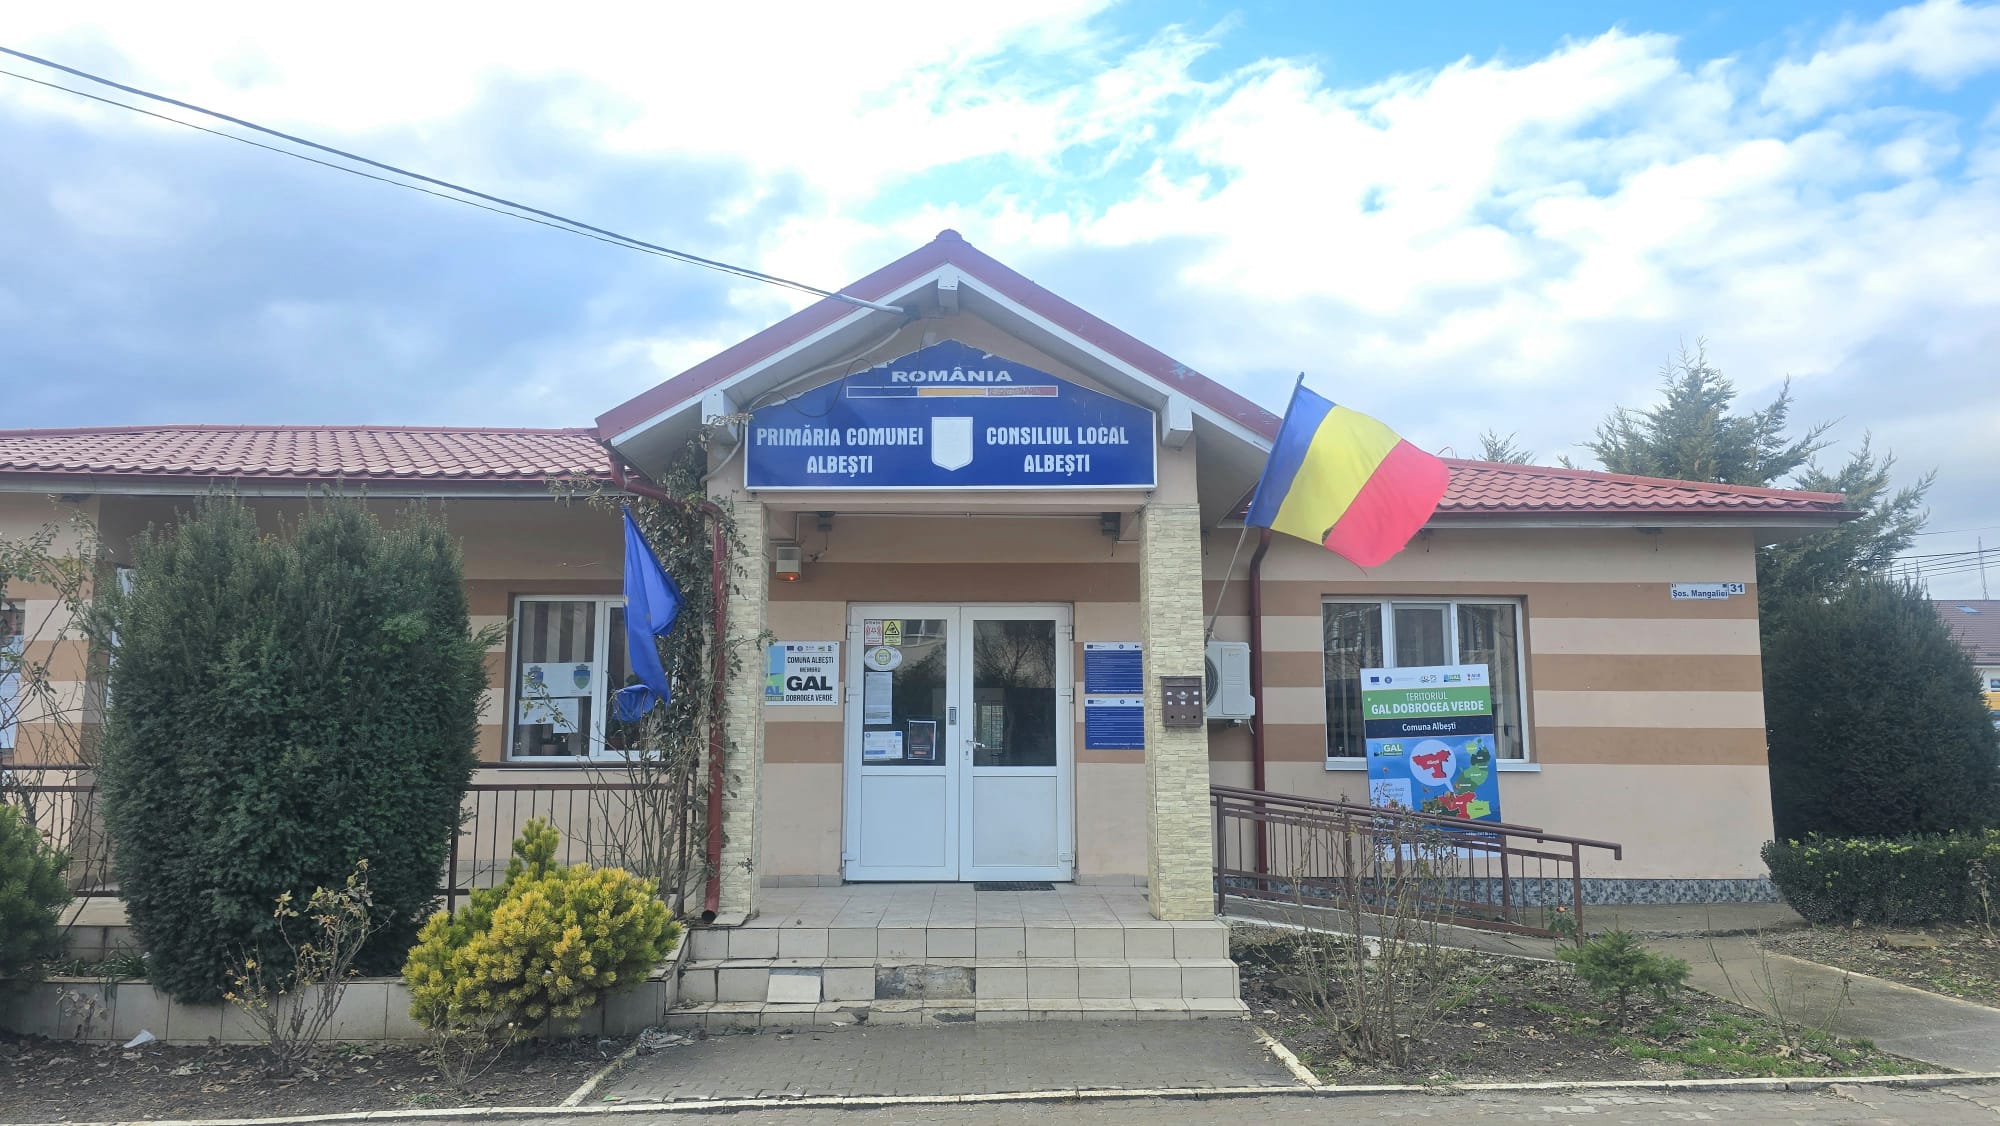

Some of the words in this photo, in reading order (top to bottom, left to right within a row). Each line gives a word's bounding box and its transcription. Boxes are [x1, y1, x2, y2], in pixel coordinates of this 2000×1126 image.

[891, 366, 1013, 383] ROMÂNIA
[756, 424, 841, 447] PRIMĂRIA
[846, 427, 924, 446] COMUNEI
[986, 427, 1073, 446] CONSILIUL
[1076, 426, 1129, 446] LOCAL
[806, 455, 873, 477] ALBEȘTI
[1024, 454, 1091, 477] ALBEȘTI
[1691, 590, 1728, 598] Mangaliei
[1730, 583, 1743, 593] 31
[787, 656, 811, 664] COMUNA
[787, 676, 832, 691] GAL
[786, 694, 814, 702] DOBROGEA
[815, 694, 833, 702] VERDE
[1406, 692, 1448, 702] TERITORIUL
[1371, 704, 1391, 715] GAL
[1393, 702, 1449, 714] DOBROGEA
[1450, 700, 1485, 711] VERDE
[1402, 723, 1431, 732] Comuna
[1432, 721, 1457, 732] Albești
[1383, 744, 1402, 752] GAL
